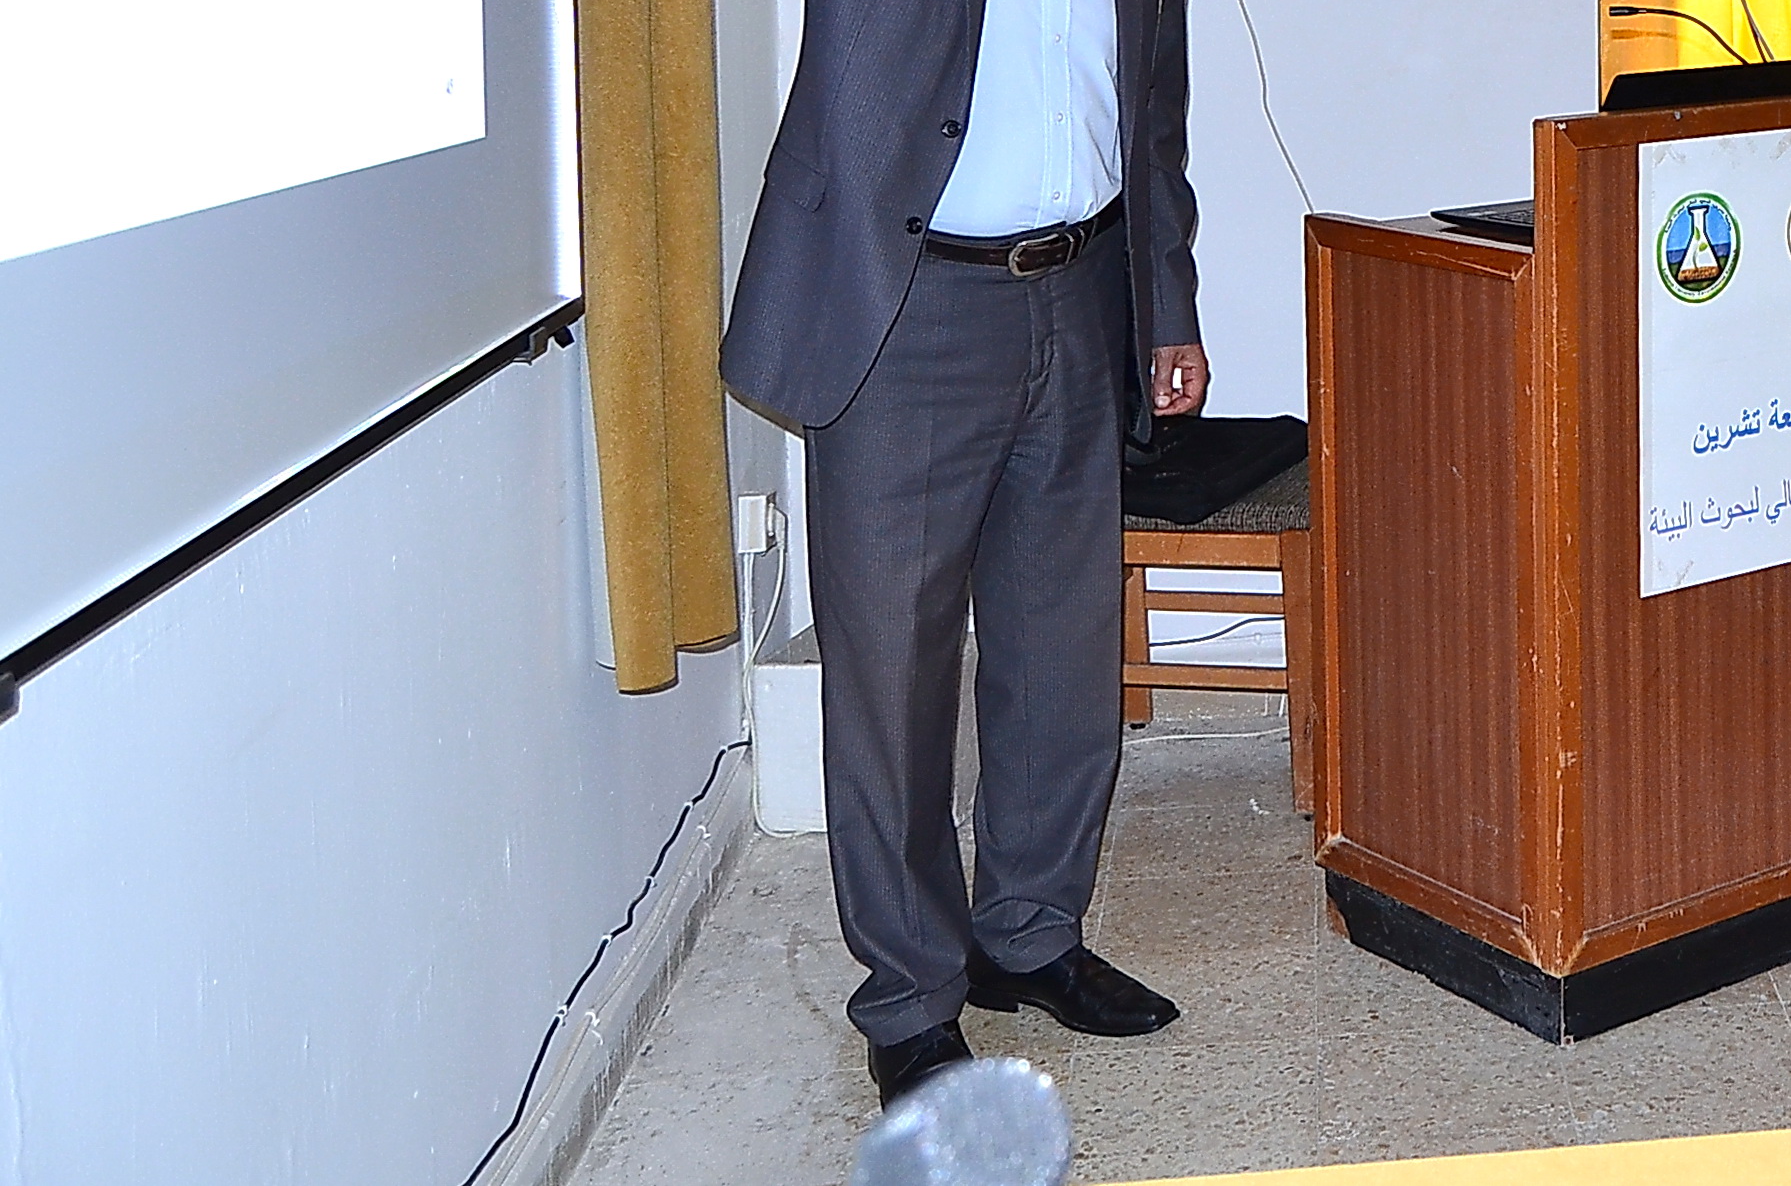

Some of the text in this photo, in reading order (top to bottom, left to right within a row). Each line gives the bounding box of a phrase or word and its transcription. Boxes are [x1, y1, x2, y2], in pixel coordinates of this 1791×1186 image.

[1693, 409, 1760, 453] تشرين
[1649, 501, 1692, 541] البيئة
[1700, 486, 1760, 529] لبحوث
